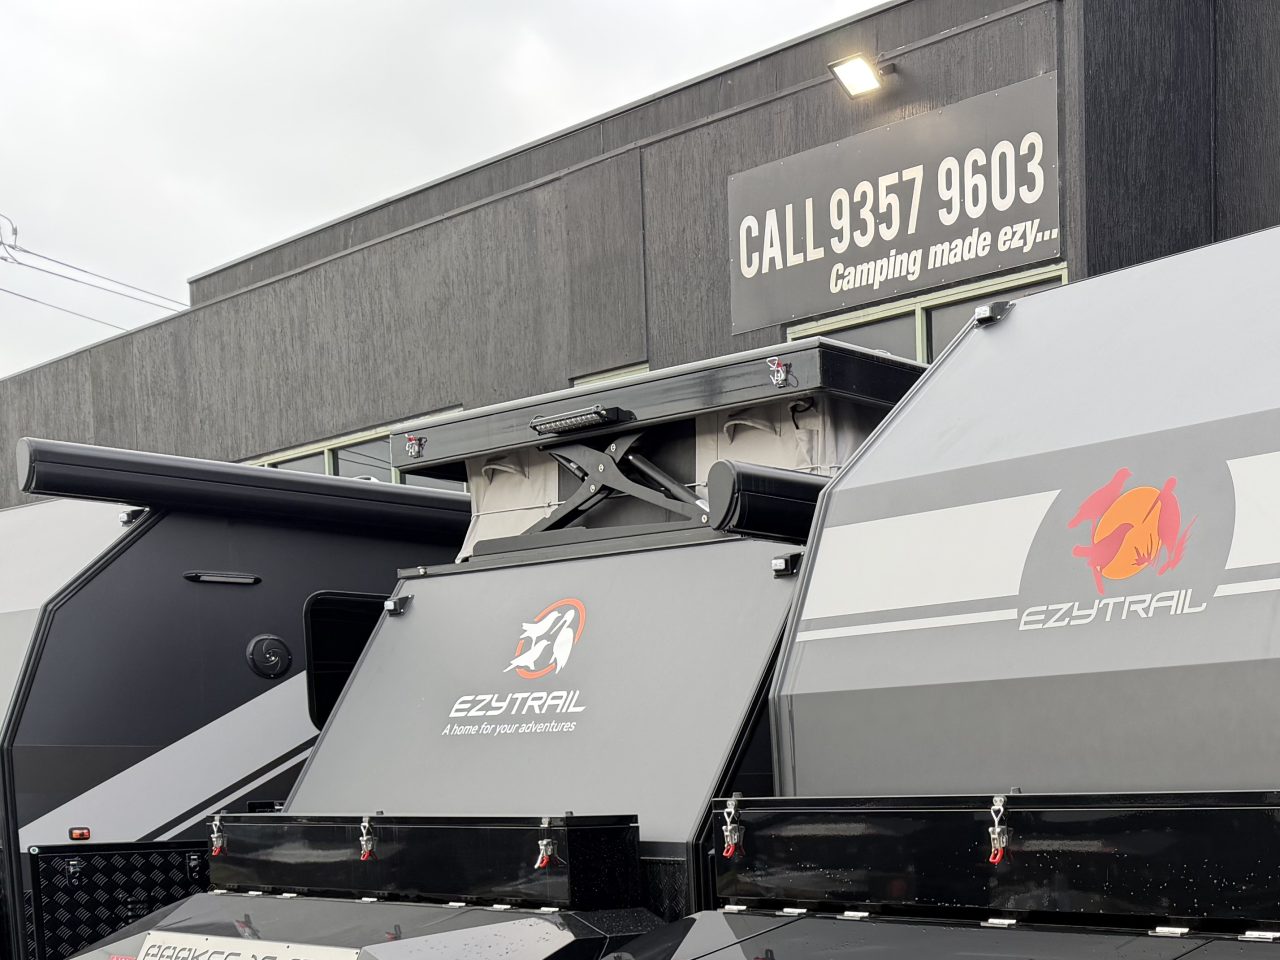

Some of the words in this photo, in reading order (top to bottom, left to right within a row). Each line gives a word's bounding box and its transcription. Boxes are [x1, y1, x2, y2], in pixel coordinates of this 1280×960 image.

[739, 197, 825, 279] CALL
[829, 164, 924, 254] 9357
[937, 131, 1045, 226] 9603
[829, 249, 922, 294] Camping
[927, 228, 991, 270] made
[997, 218, 1059, 254] ezy...
[1018, 588, 1207, 631] EZYTRAIL
[449, 690, 587, 718] EZYTRAIL
[441, 723, 451, 736] A
[450, 722, 478, 736] home
[478, 721, 493, 736] for
[493, 722, 520, 737] your
[518, 719, 577, 734] adventures
